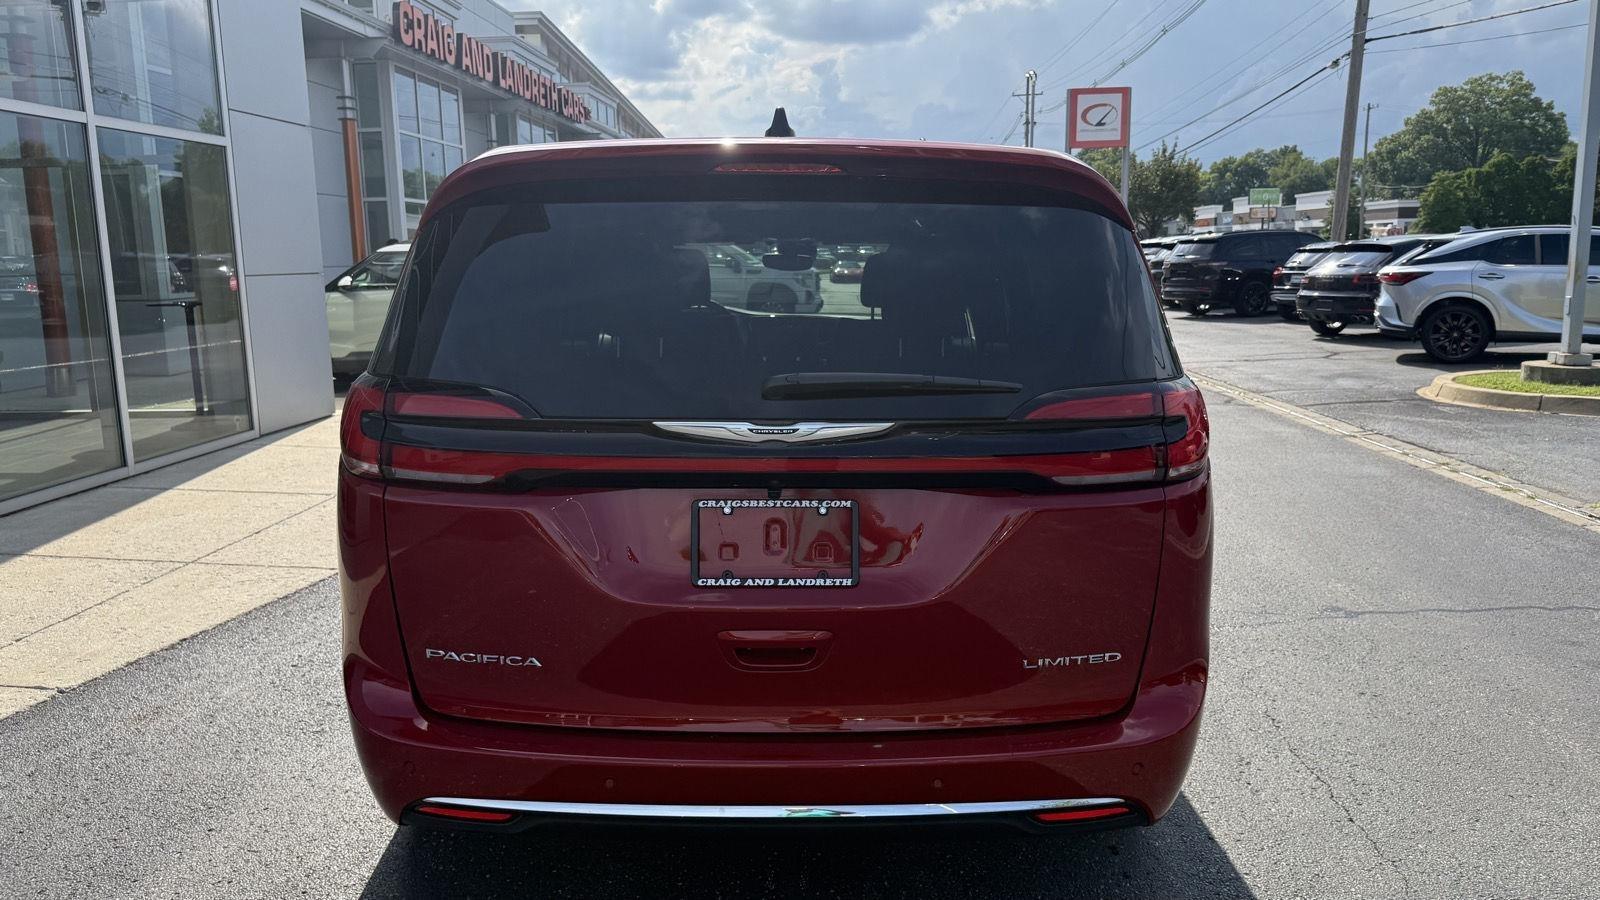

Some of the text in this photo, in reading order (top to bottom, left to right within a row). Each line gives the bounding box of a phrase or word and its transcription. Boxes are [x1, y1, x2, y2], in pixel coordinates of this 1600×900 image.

[398, 0, 588, 124] CRAIG AND LANDRETH CARS
[698, 500, 852, 508] CRAIGSBESTCARS.COM
[697, 578, 853, 586] CRAIG AND LANDRETH
[425, 648, 542, 667] PACIFICA
[1022, 652, 1122, 669] LIMITED
